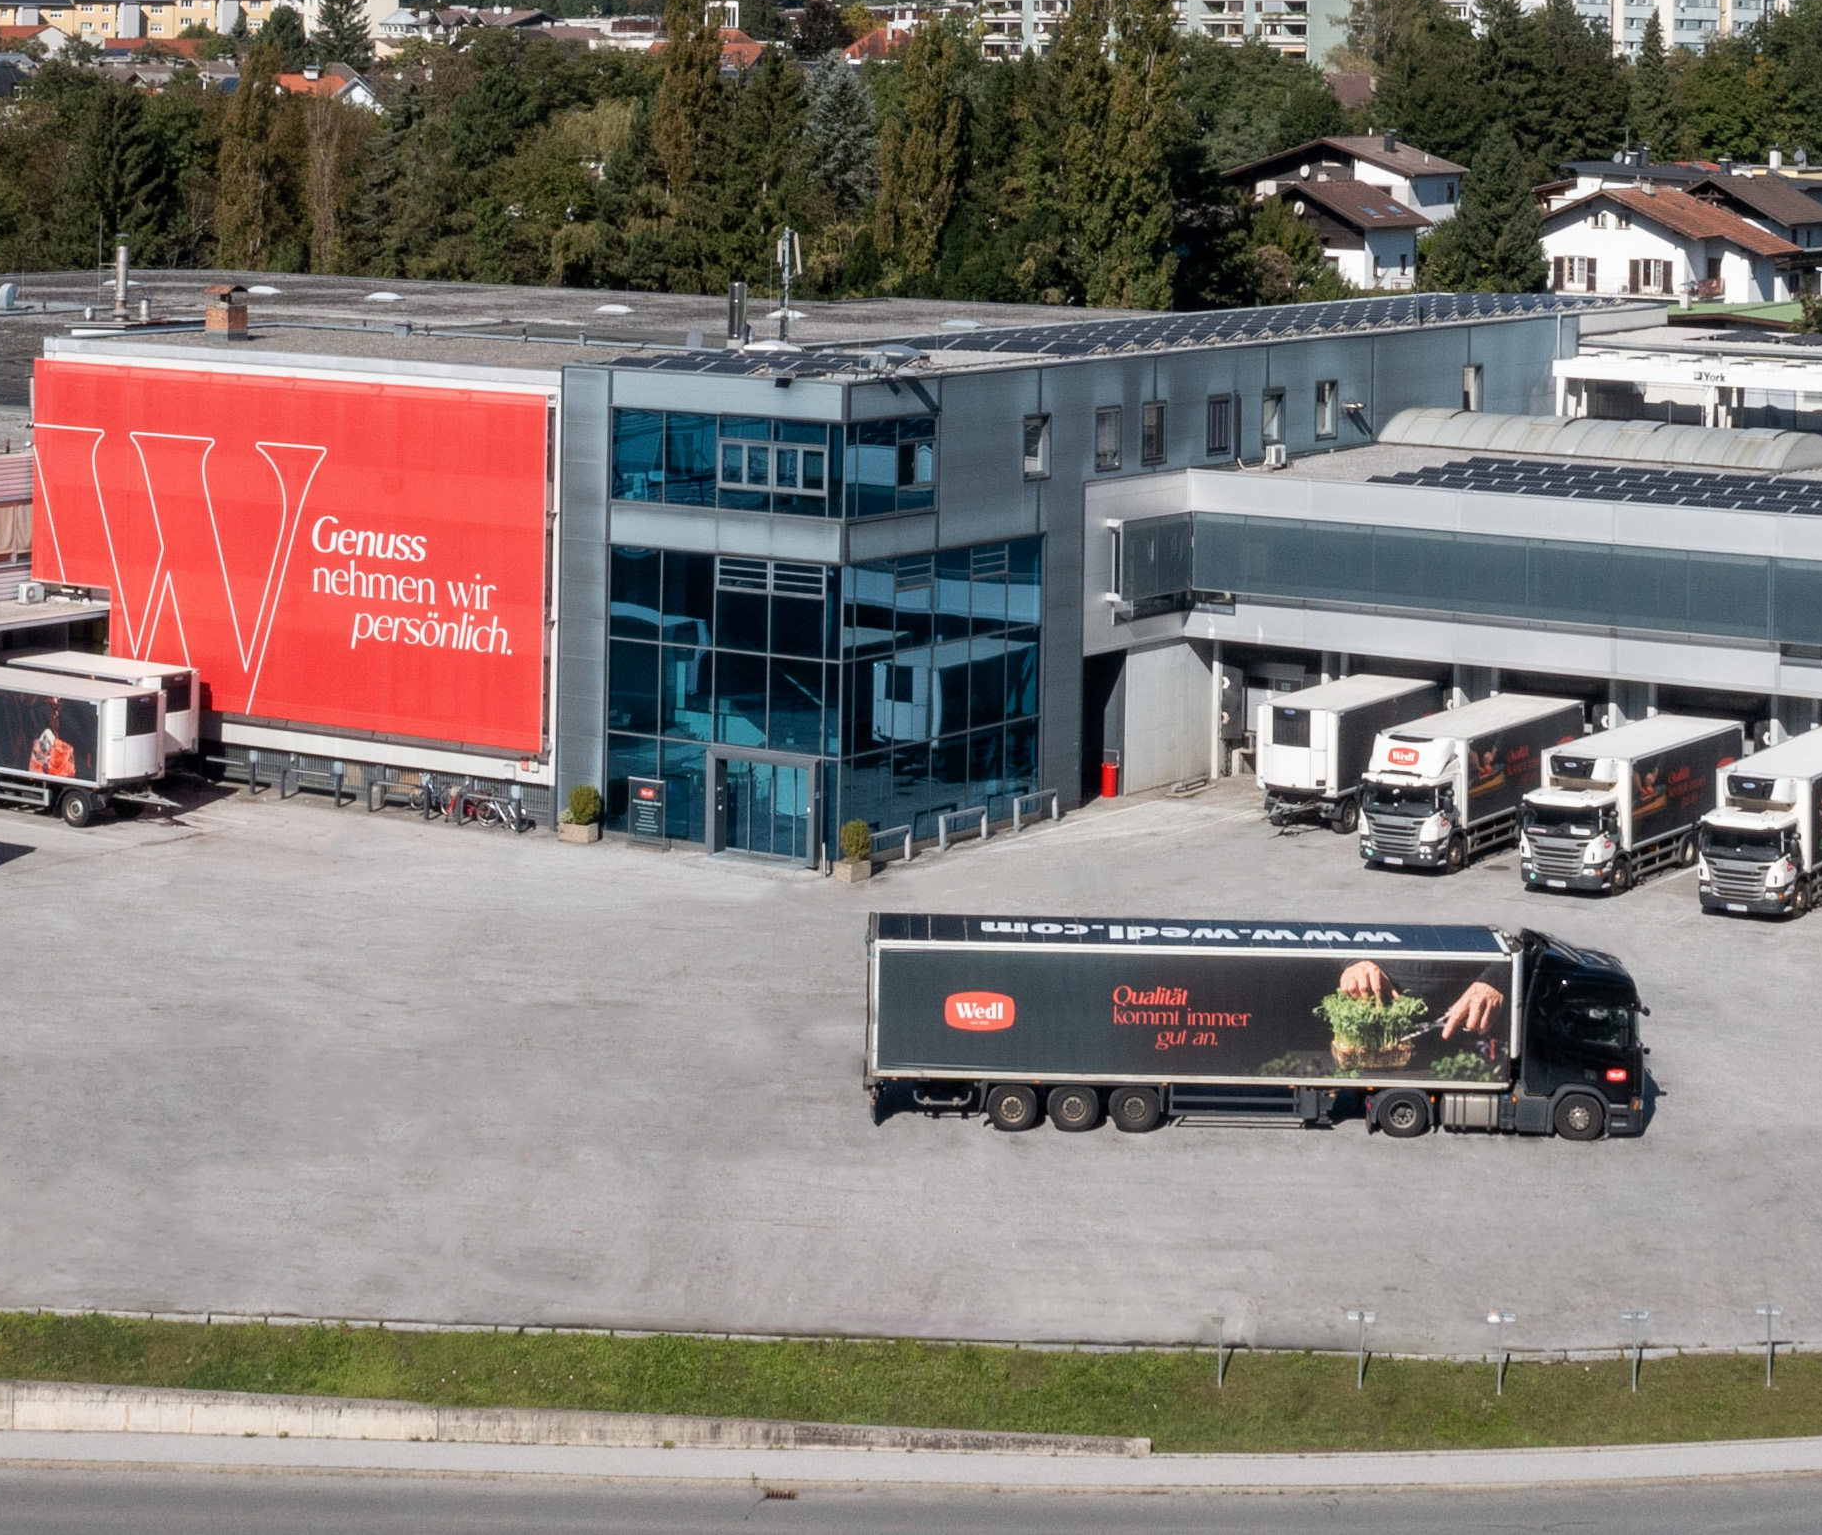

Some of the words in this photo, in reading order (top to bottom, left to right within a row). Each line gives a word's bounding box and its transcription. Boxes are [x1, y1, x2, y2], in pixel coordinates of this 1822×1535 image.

[1704, 372, 1726, 382] York
[312, 515, 427, 562] Genuss
[312, 560, 436, 605] nehmen
[447, 573, 497, 610] wir
[351, 611, 513, 656] persönlich.
[980, 920, 1402, 943] www.wedl.com
[1112, 985, 1188, 1007] Qualität
[955, 1002, 1004, 1020] Wedl
[1112, 1005, 1179, 1025] kommt
[1186, 1008, 1253, 1027] immer
[1155, 1029, 1187, 1050] gut
[1192, 1031, 1219, 1046] an.
